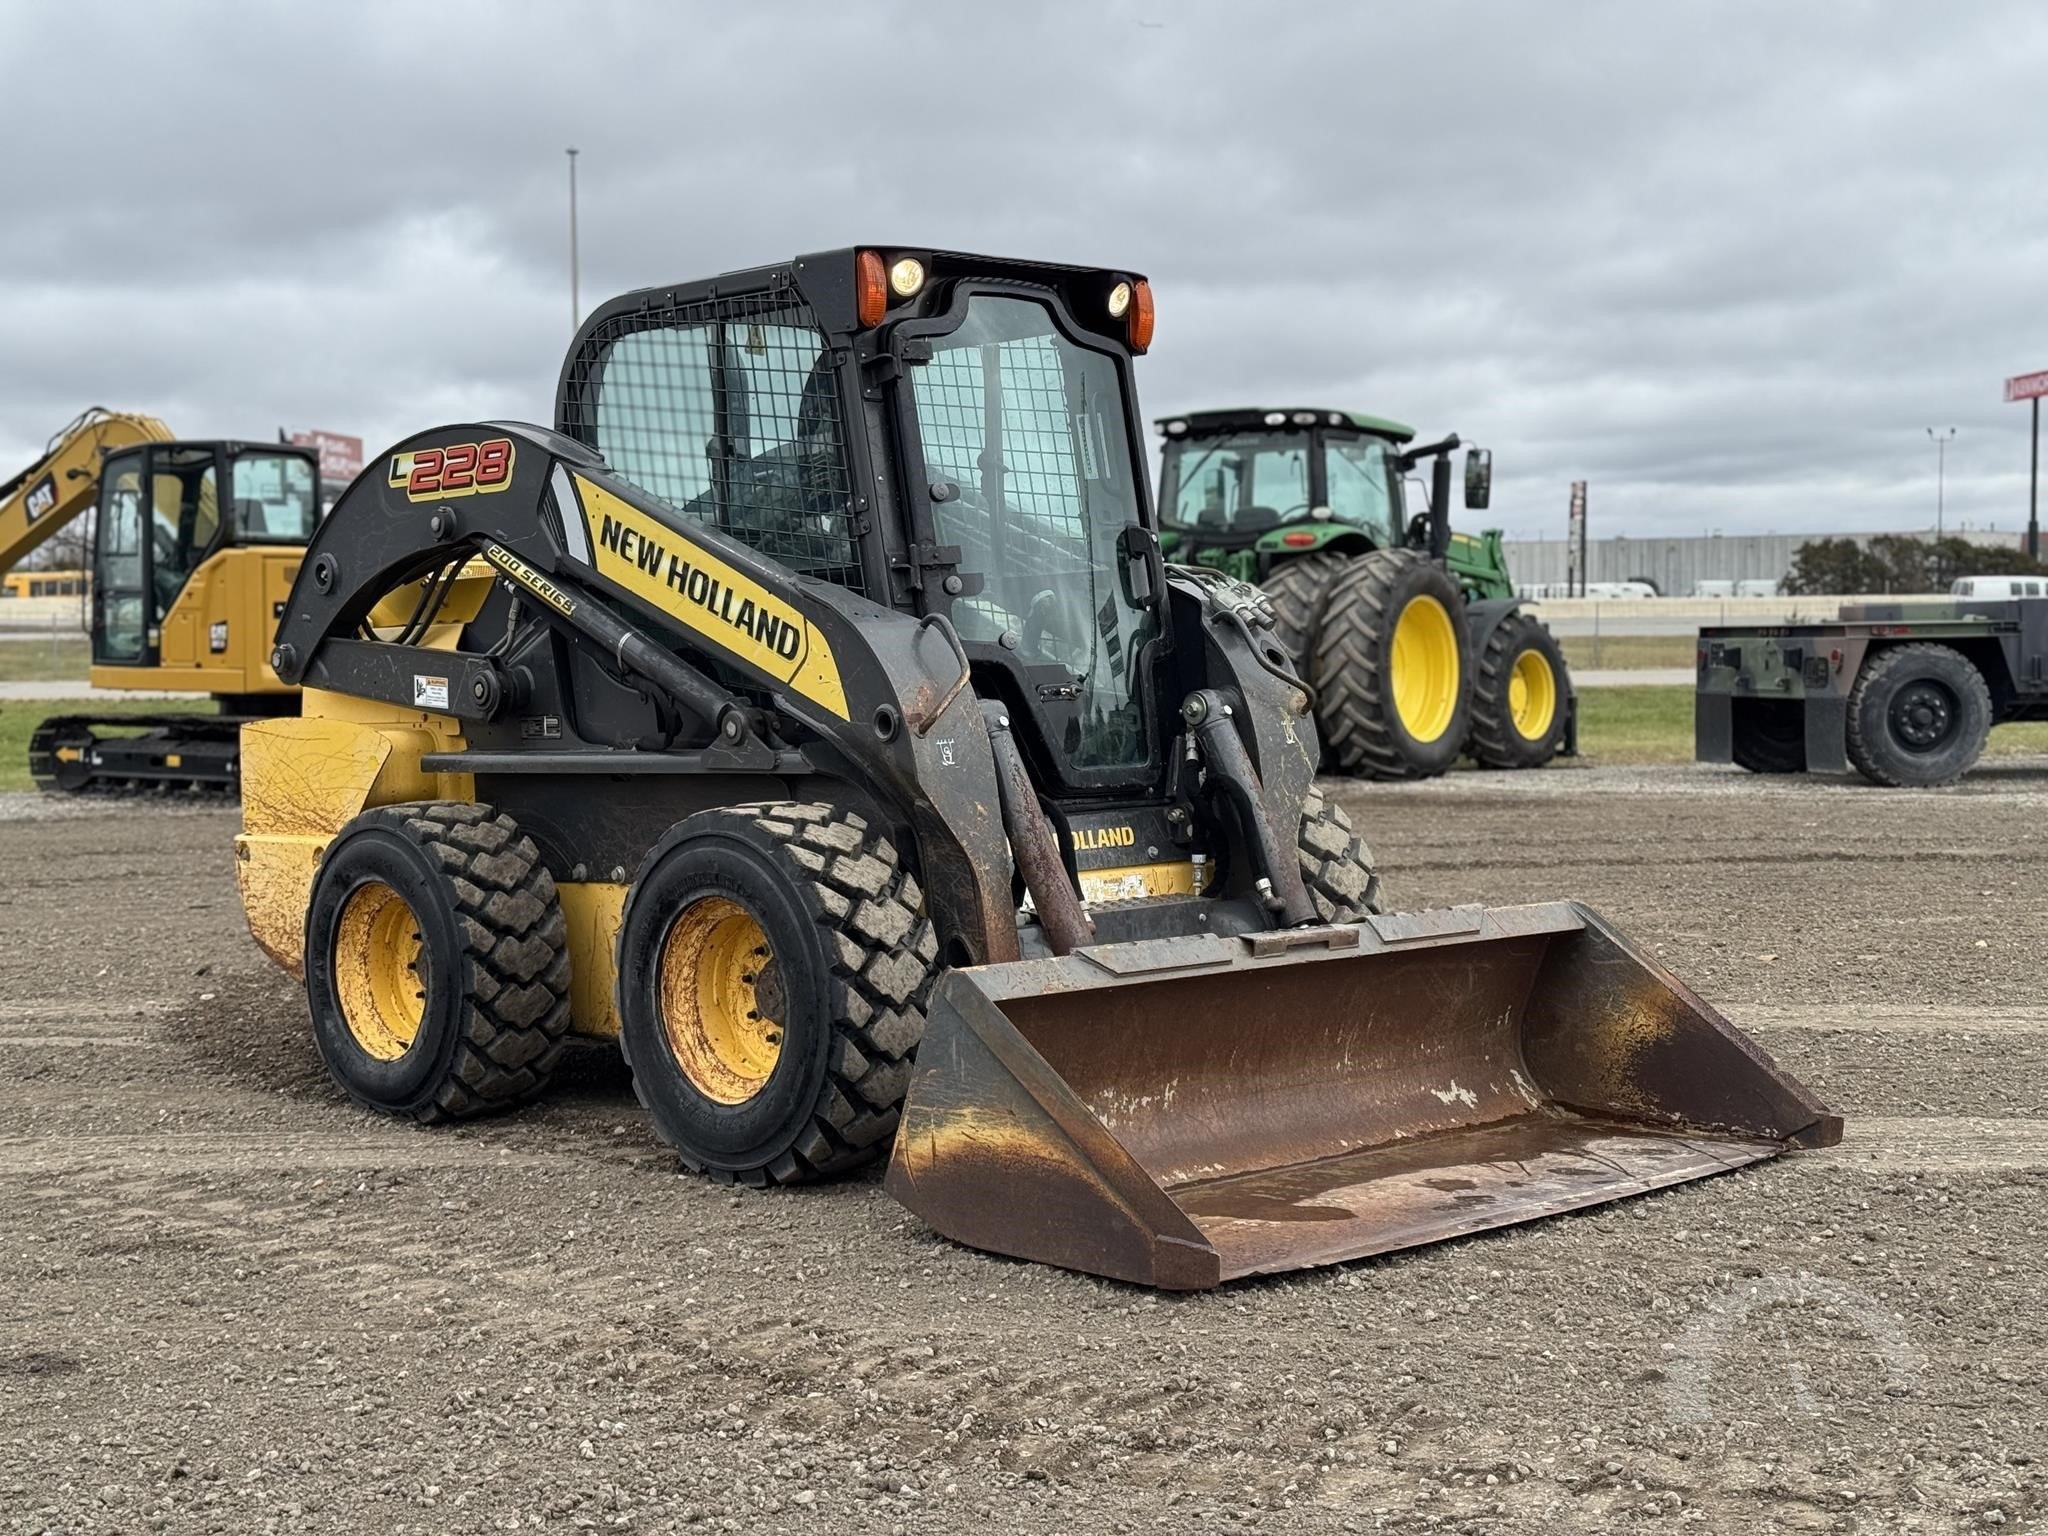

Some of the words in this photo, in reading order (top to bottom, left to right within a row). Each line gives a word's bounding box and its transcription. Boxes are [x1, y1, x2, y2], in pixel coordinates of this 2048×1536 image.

[27, 483, 54, 518] CAT
[389, 440, 513, 499] L228
[488, 545, 521, 572] 200
[520, 569, 574, 613] SERIES
[600, 514, 665, 577] NEW
[667, 554, 800, 661] HOLLAND
